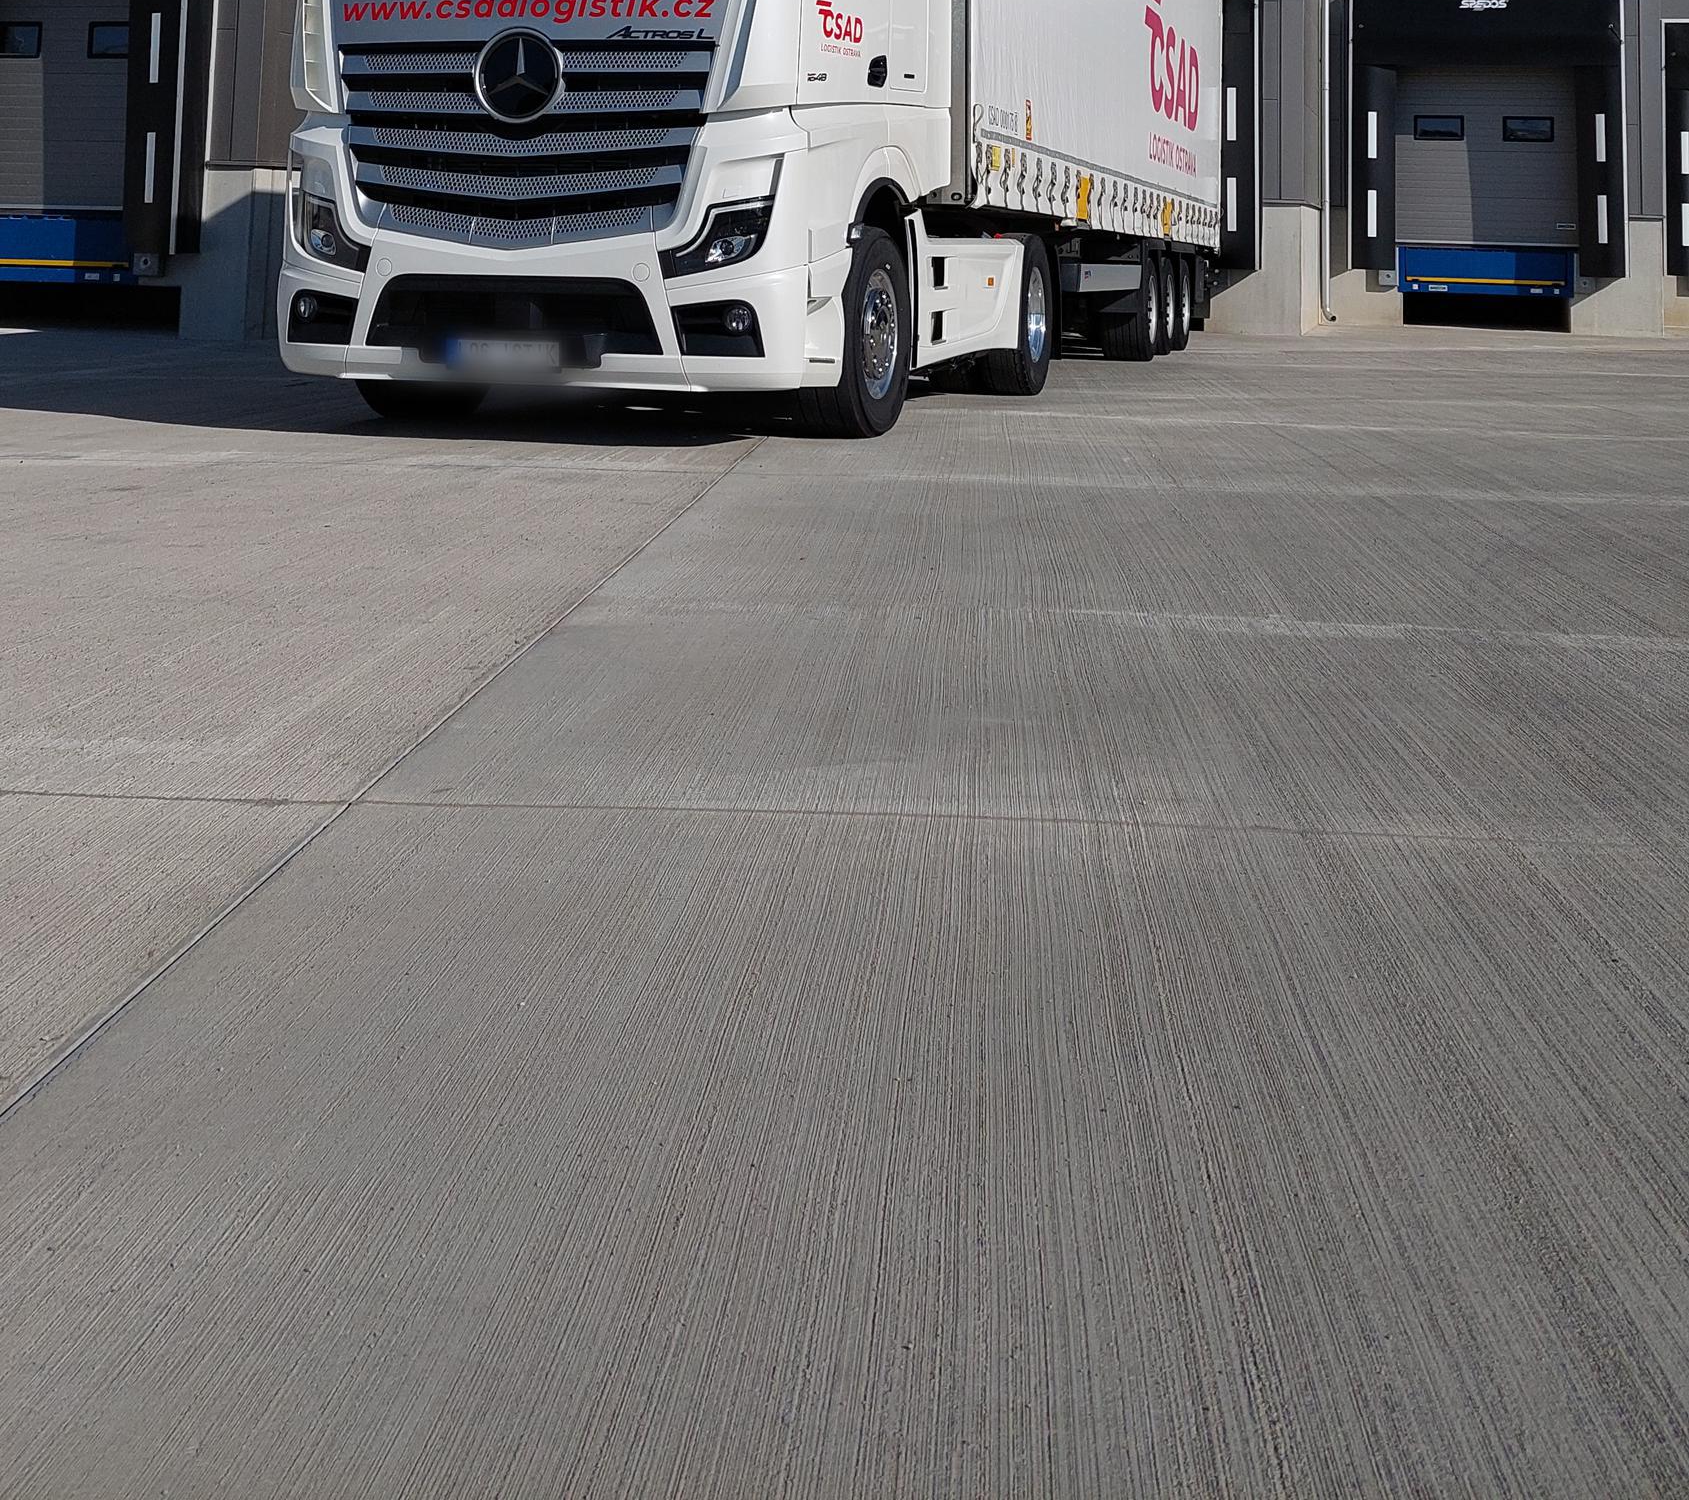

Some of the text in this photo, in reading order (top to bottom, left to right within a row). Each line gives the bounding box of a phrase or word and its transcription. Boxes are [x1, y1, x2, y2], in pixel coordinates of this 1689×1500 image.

[696, 28, 714, 40] L
[1149, 131, 1197, 178] LOGISTIK OSTRAVA
